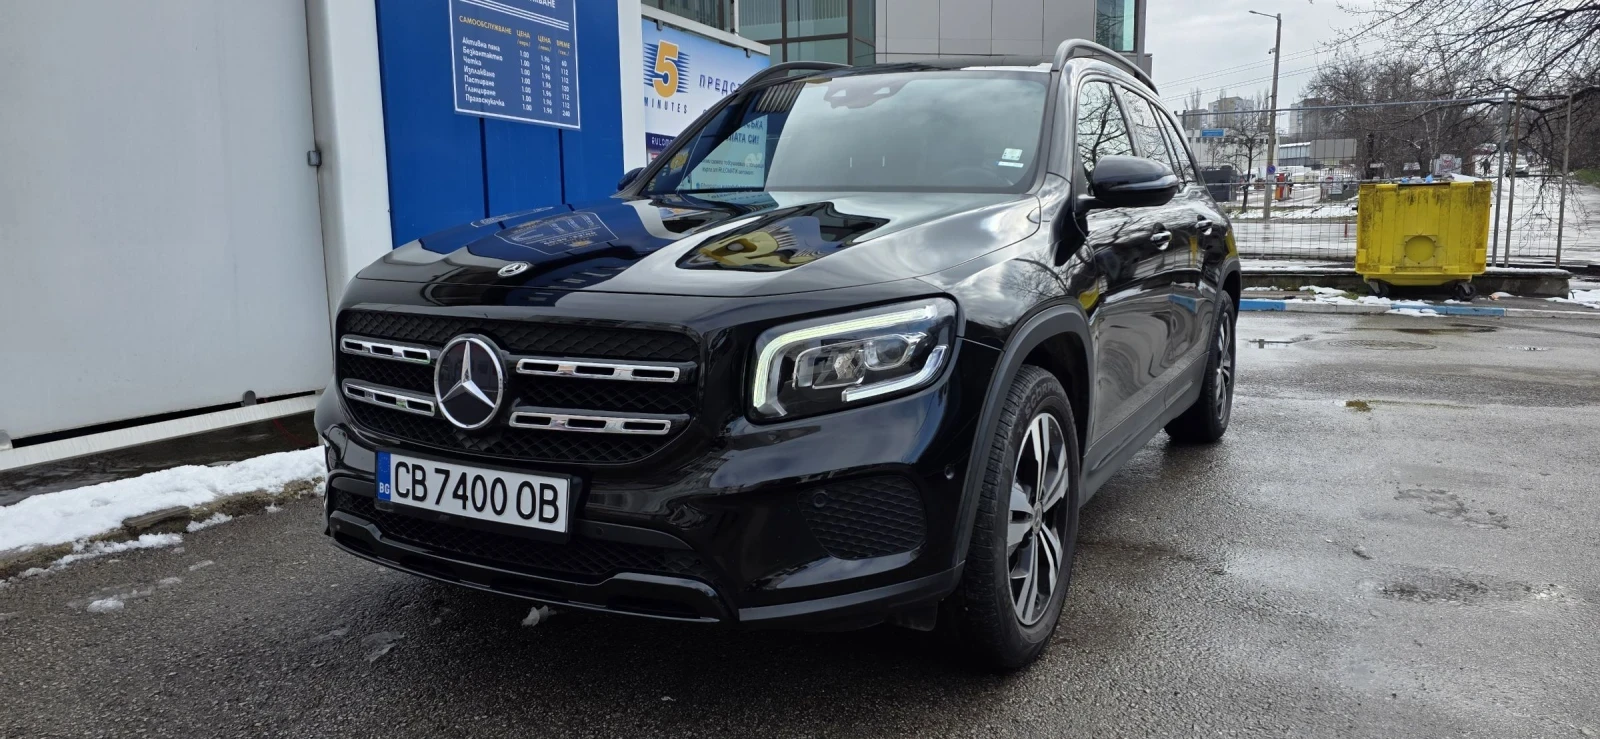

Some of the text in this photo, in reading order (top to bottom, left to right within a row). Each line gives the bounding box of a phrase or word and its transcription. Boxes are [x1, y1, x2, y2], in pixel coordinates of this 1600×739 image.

[459, 15, 570, 49] САМООБСЛУЖВАНЕ ЦЕНА ЦЕНА ВРЕМЕ
[462, 36, 486, 49] Активна
[520, 50, 530, 58] 1.00
[541, 55, 550, 63] 1.96
[463, 56, 569, 84] Четка 1.00 1.96 112
[464, 65, 495, 78] Изплакване
[541, 64, 550, 72] 1.96
[560, 68, 568, 76] 112
[652, 40, 679, 98] 5
[464, 74, 494, 87] Пастиране
[522, 86, 531, 94] 1.00
[465, 84, 496, 96] Гланциране
[543, 98, 552, 106] 1.96
[466, 94, 505, 106] Прахосмукачка
[544, 106, 552, 114] 1.96
[644, 96, 687, 114] MINUTES
[379, 482, 390, 494] BG
[394, 461, 559, 524] CB 7400 OB
